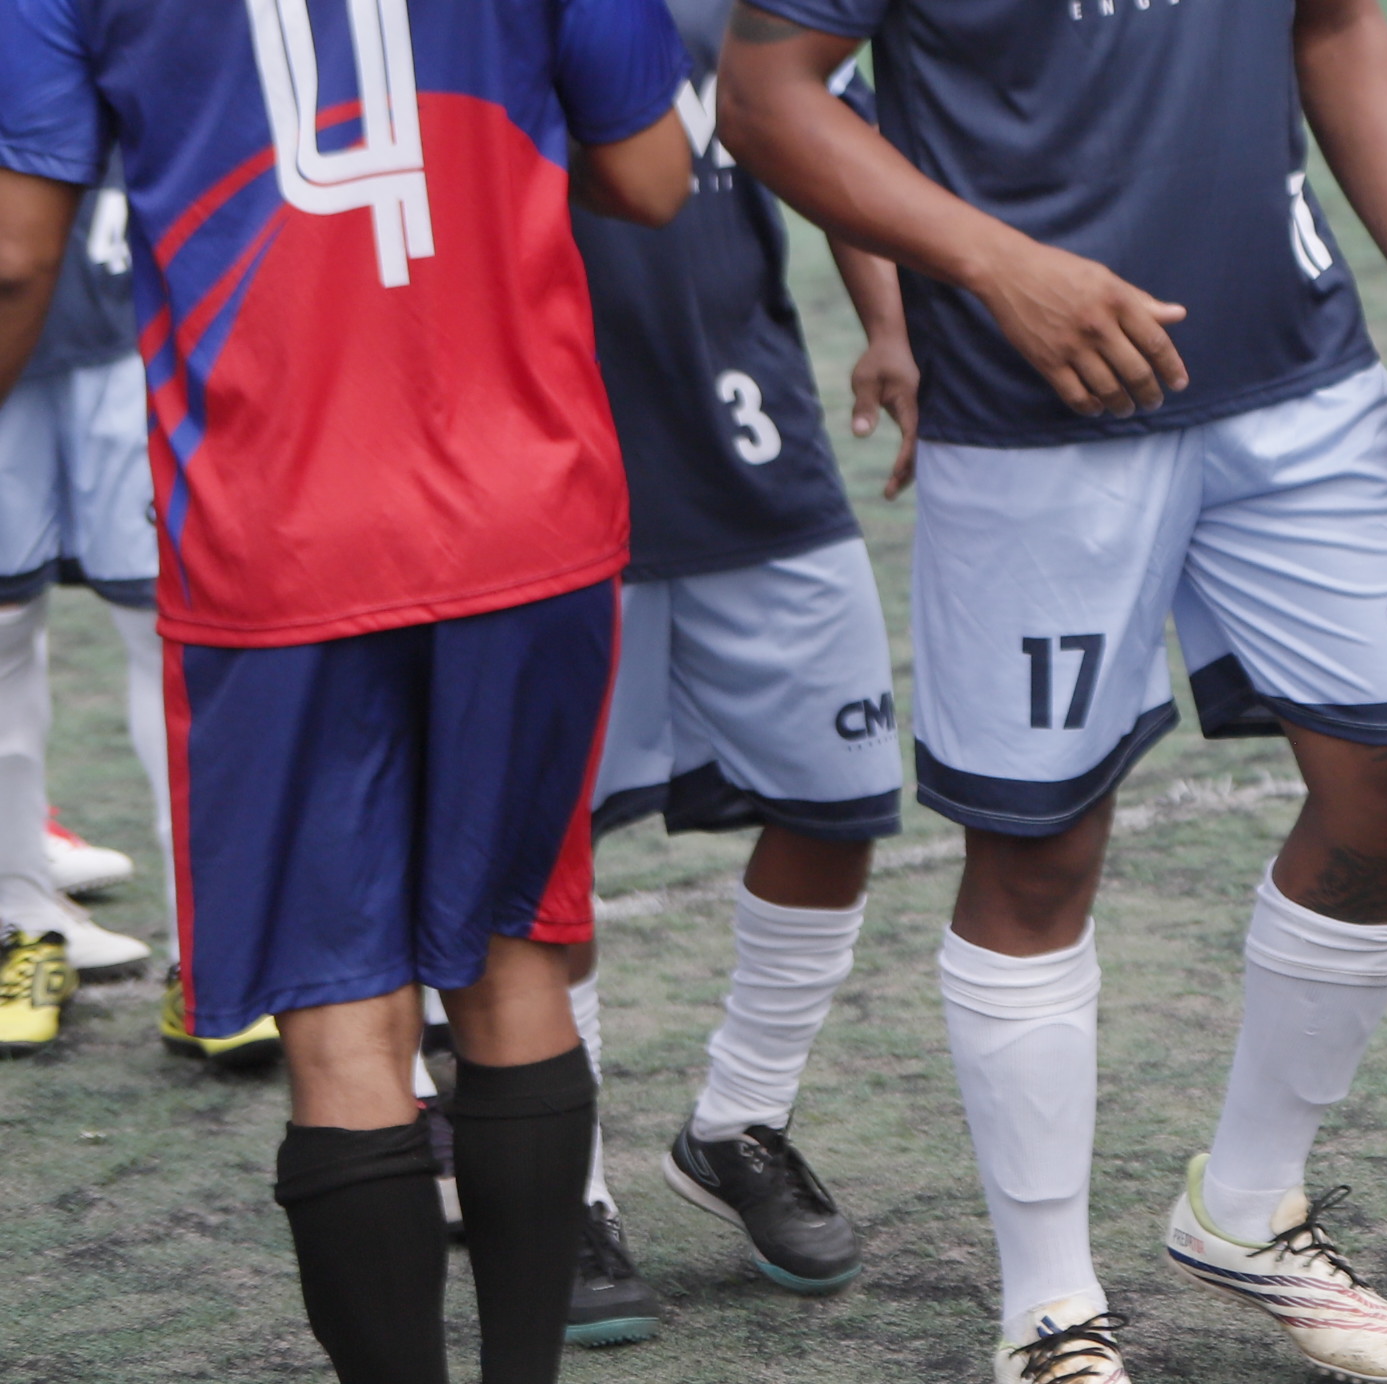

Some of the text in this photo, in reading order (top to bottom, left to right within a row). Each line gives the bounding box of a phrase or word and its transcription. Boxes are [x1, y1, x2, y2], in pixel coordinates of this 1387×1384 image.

[87, 189, 133, 274] 4
[716, 369, 782, 467] 3
[1021, 633, 1106, 730] 17
